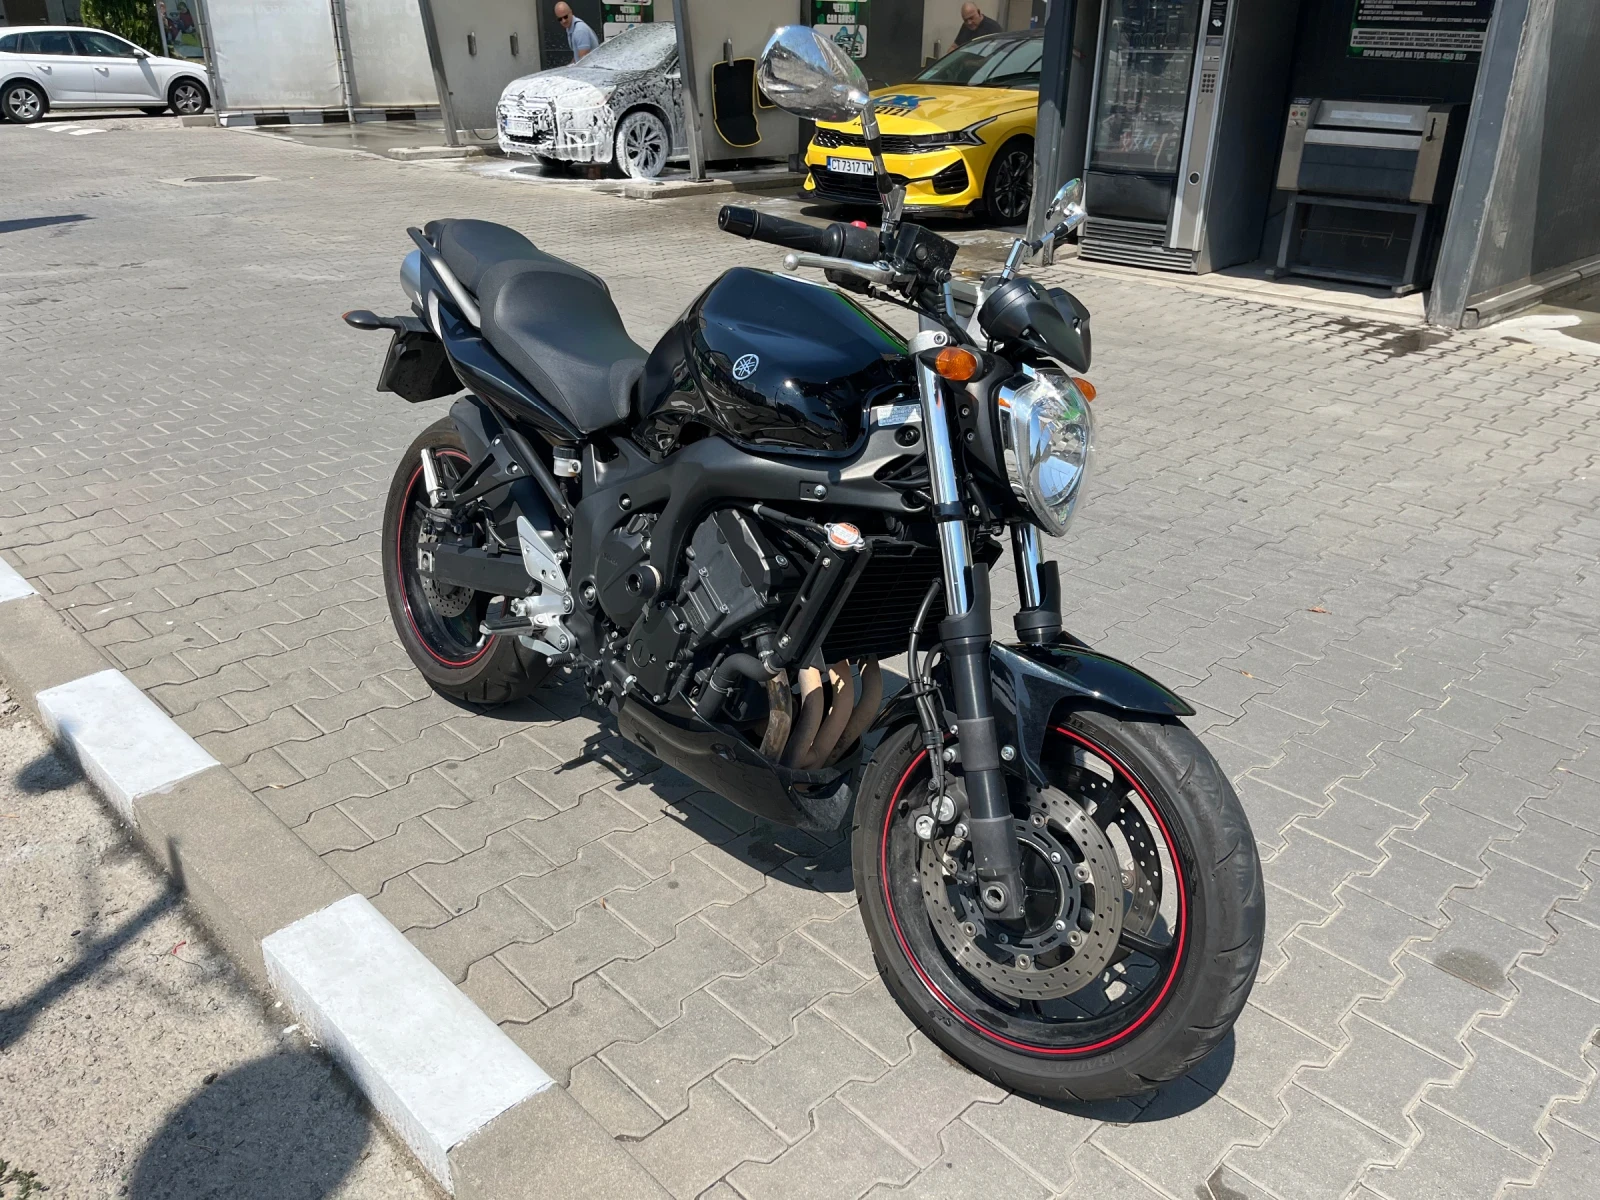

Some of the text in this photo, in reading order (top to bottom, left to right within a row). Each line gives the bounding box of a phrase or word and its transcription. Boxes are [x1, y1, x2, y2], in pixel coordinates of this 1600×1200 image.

[833, 3, 850, 13] ЧЕТКА
[827, 14, 855, 24] CAR BRUSH
[831, 159, 873, 175] CT 7317 TM
